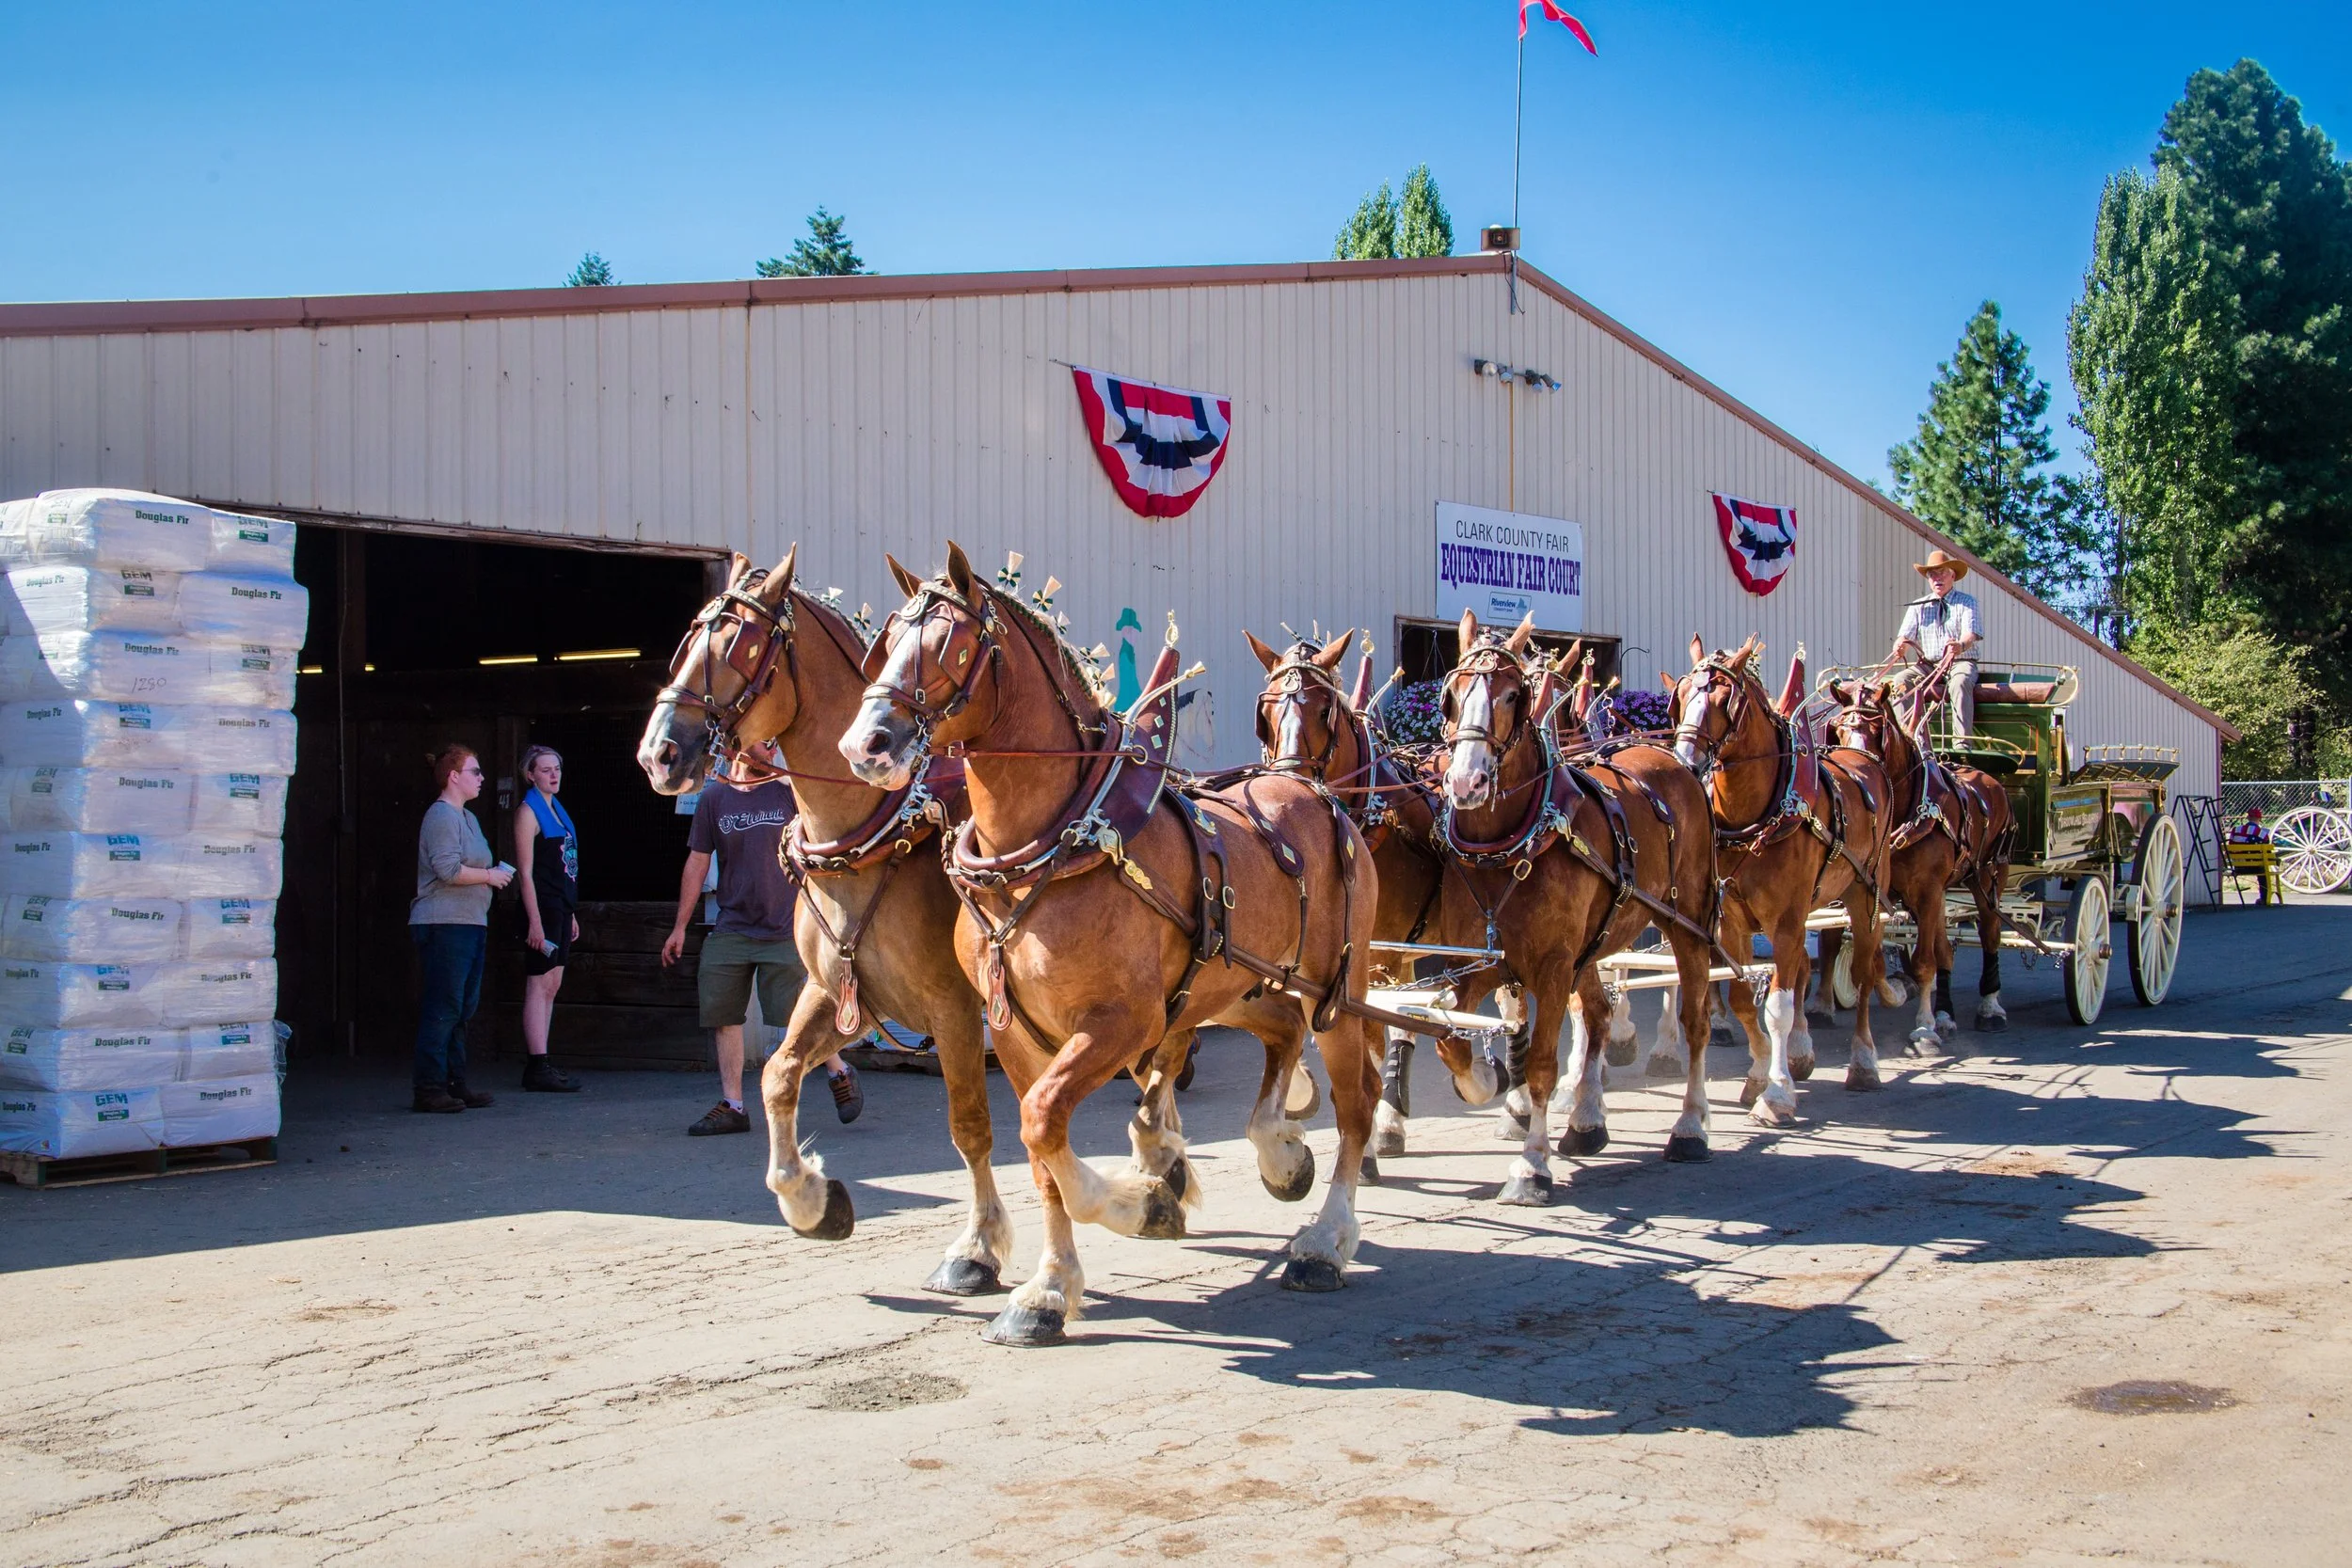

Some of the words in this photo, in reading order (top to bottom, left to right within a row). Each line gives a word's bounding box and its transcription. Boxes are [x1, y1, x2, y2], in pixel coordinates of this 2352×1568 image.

[135, 511, 174, 524] Douglas
[177, 515, 190, 525] Fir
[1455, 520, 1494, 543] CLARK
[1496, 527, 1543, 549] COUNTY
[1546, 533, 1569, 553] FAIR
[120, 569, 152, 581] GEM
[1440, 543, 1515, 591] EQUESTRIAN
[1517, 553, 1546, 593] FAIR
[1548, 557, 1581, 596] COURT
[26, 577, 53, 587] Douglas
[231, 587, 268, 599] Douglas
[270, 590, 282, 600] Fir
[1491, 597, 1517, 609] Riverview
[124, 642, 164, 656] Douglas
[167, 646, 179, 656] Fir
[132, 677, 167, 693] 1280
[26, 709, 51, 721] Douglas
[53, 707, 62, 717] Fir
[218, 719, 256, 729] Douglas
[259, 719, 271, 728] Fir
[119, 777, 158, 789] Douglas
[161, 779, 174, 789] Fir
[230, 773, 260, 784] GEM
[107, 834, 140, 846] GEM
[15, 843, 40, 854] Douglas
[41, 842, 51, 851] Fir
[204, 845, 241, 856] Douglas
[244, 845, 256, 854] Fir
[221, 898, 250, 909] GEM
[111, 907, 150, 920] Douglas
[151, 911, 165, 921] Fir
[240, 972, 252, 980] Fir
[94, 1037, 135, 1048] Douglas
[137, 1037, 151, 1046] Fir
[95, 1093, 128, 1106] GEM
[199, 1089, 237, 1101] Douglas
[240, 1087, 252, 1096] Fir
